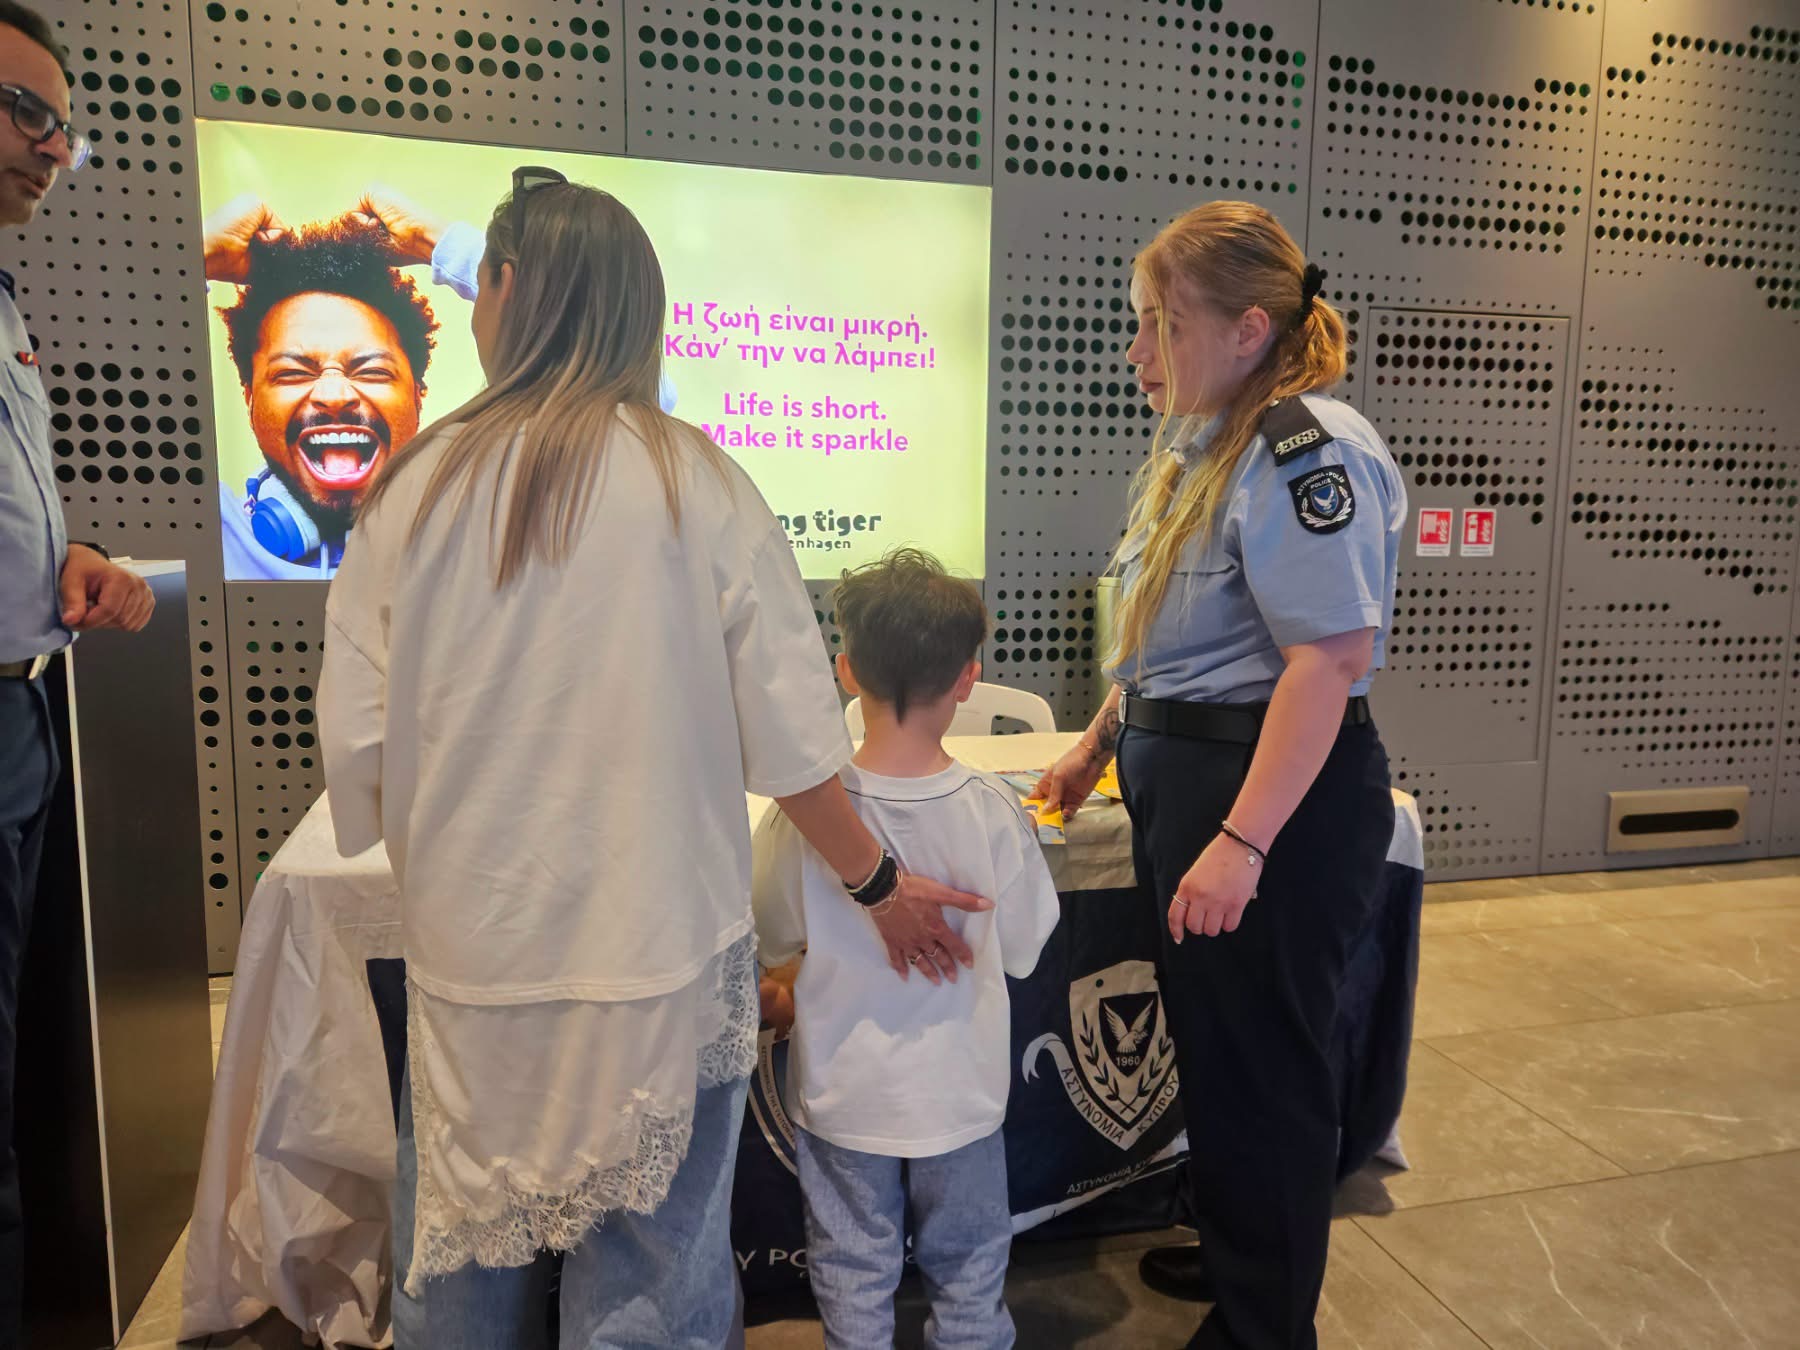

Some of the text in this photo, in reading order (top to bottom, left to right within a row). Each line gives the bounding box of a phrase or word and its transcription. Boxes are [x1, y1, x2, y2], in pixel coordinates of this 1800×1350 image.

[673, 302, 928, 345] Η ζωή είναι μικρή.
[737, 344, 785, 369] την
[793, 346, 826, 364] να
[834, 341, 936, 373] λάμπει!
[724, 391, 888, 421] Life is short.
[701, 423, 909, 456] Make it sparkle
[1310, 478, 1331, 489] POLICE
[812, 508, 882, 537] tiger
[788, 537, 852, 552] enhagen
[1115, 1056, 1141, 1067] 1960
[1061, 1067, 1125, 1143] ΑΣΤΥΝΟΜΙΑ
